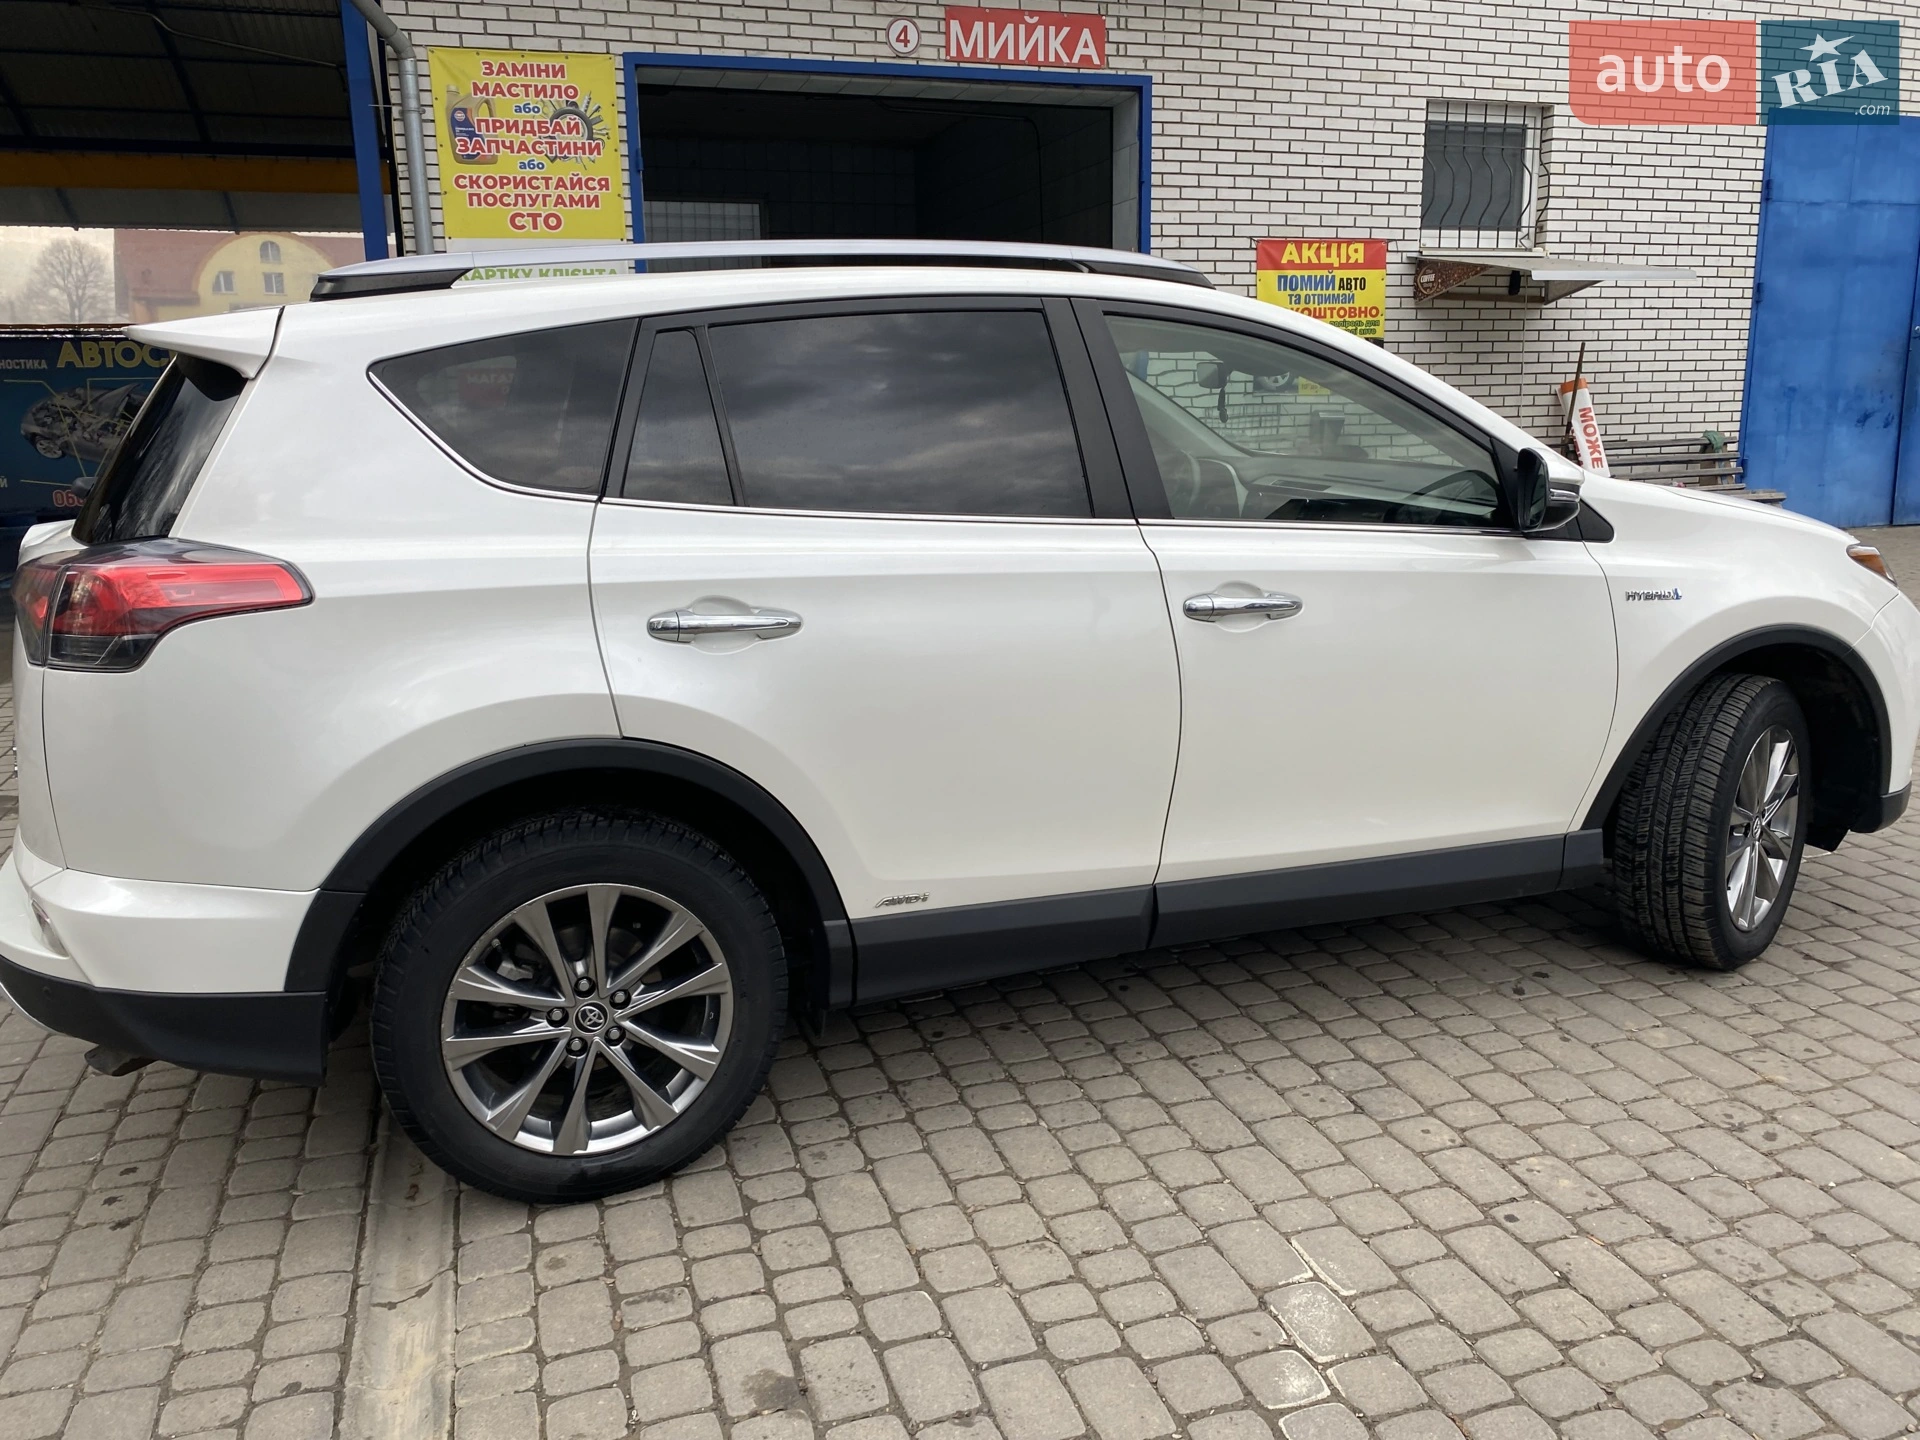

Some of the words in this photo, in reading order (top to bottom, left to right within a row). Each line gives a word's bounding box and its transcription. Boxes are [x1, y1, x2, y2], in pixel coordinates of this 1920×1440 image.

[895, 25, 910, 48] 4
[950, 16, 1100, 65] МИЙКА
[481, 61, 566, 79] ЗАМІНИ
[472, 82, 579, 100] МАСТИЛО
[514, 102, 541, 114] або
[475, 117, 581, 137] ПРИДБАЙ
[456, 137, 602, 156] ЗАПЧАСТИНИ
[518, 159, 545, 171] або
[453, 173, 610, 192] СКОРИСТАЙСЯ
[467, 192, 601, 208] ПОСЛУГАМИ
[508, 212, 563, 231] СТО
[1281, 242, 1365, 267] АКЦІЯ
[1278, 270, 1336, 291] ПОМИЙ
[1338, 277, 1366, 291] АВТО
[1288, 294, 1301, 305] та
[1304, 289, 1355, 306] отримай
[57, 341, 176, 368] АВТОС
[1579, 407, 1604, 469] МОЖЕ
